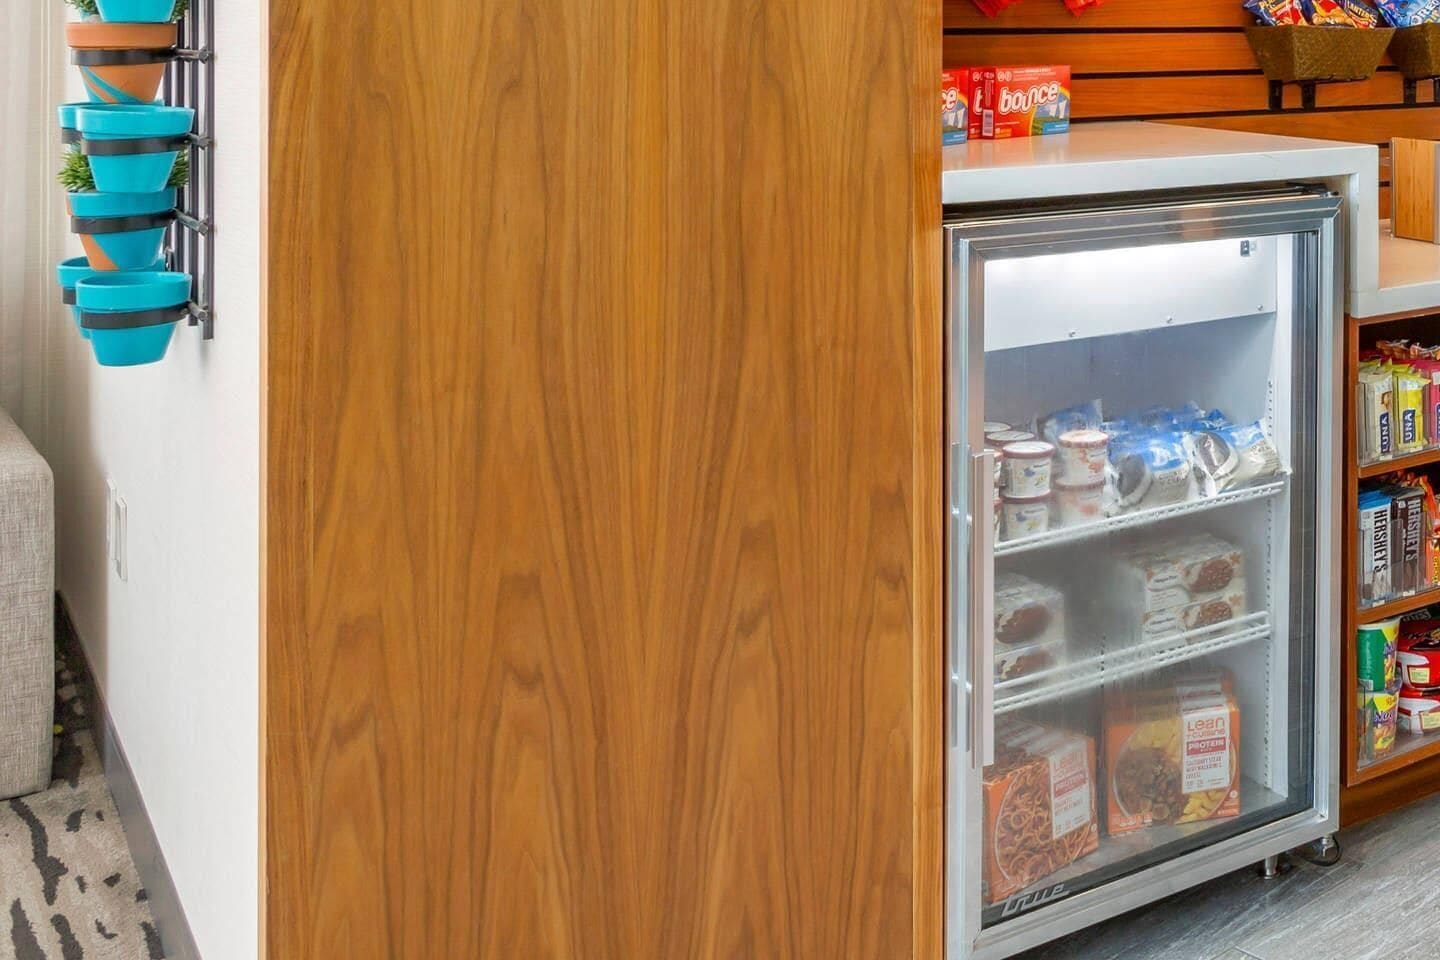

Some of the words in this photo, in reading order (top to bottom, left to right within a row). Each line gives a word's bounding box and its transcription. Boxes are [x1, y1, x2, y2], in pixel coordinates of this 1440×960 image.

[999, 81, 1059, 114] bounce
[1187, 717, 1226, 732] Lean
[1188, 739, 1226, 751] PROTEIN
